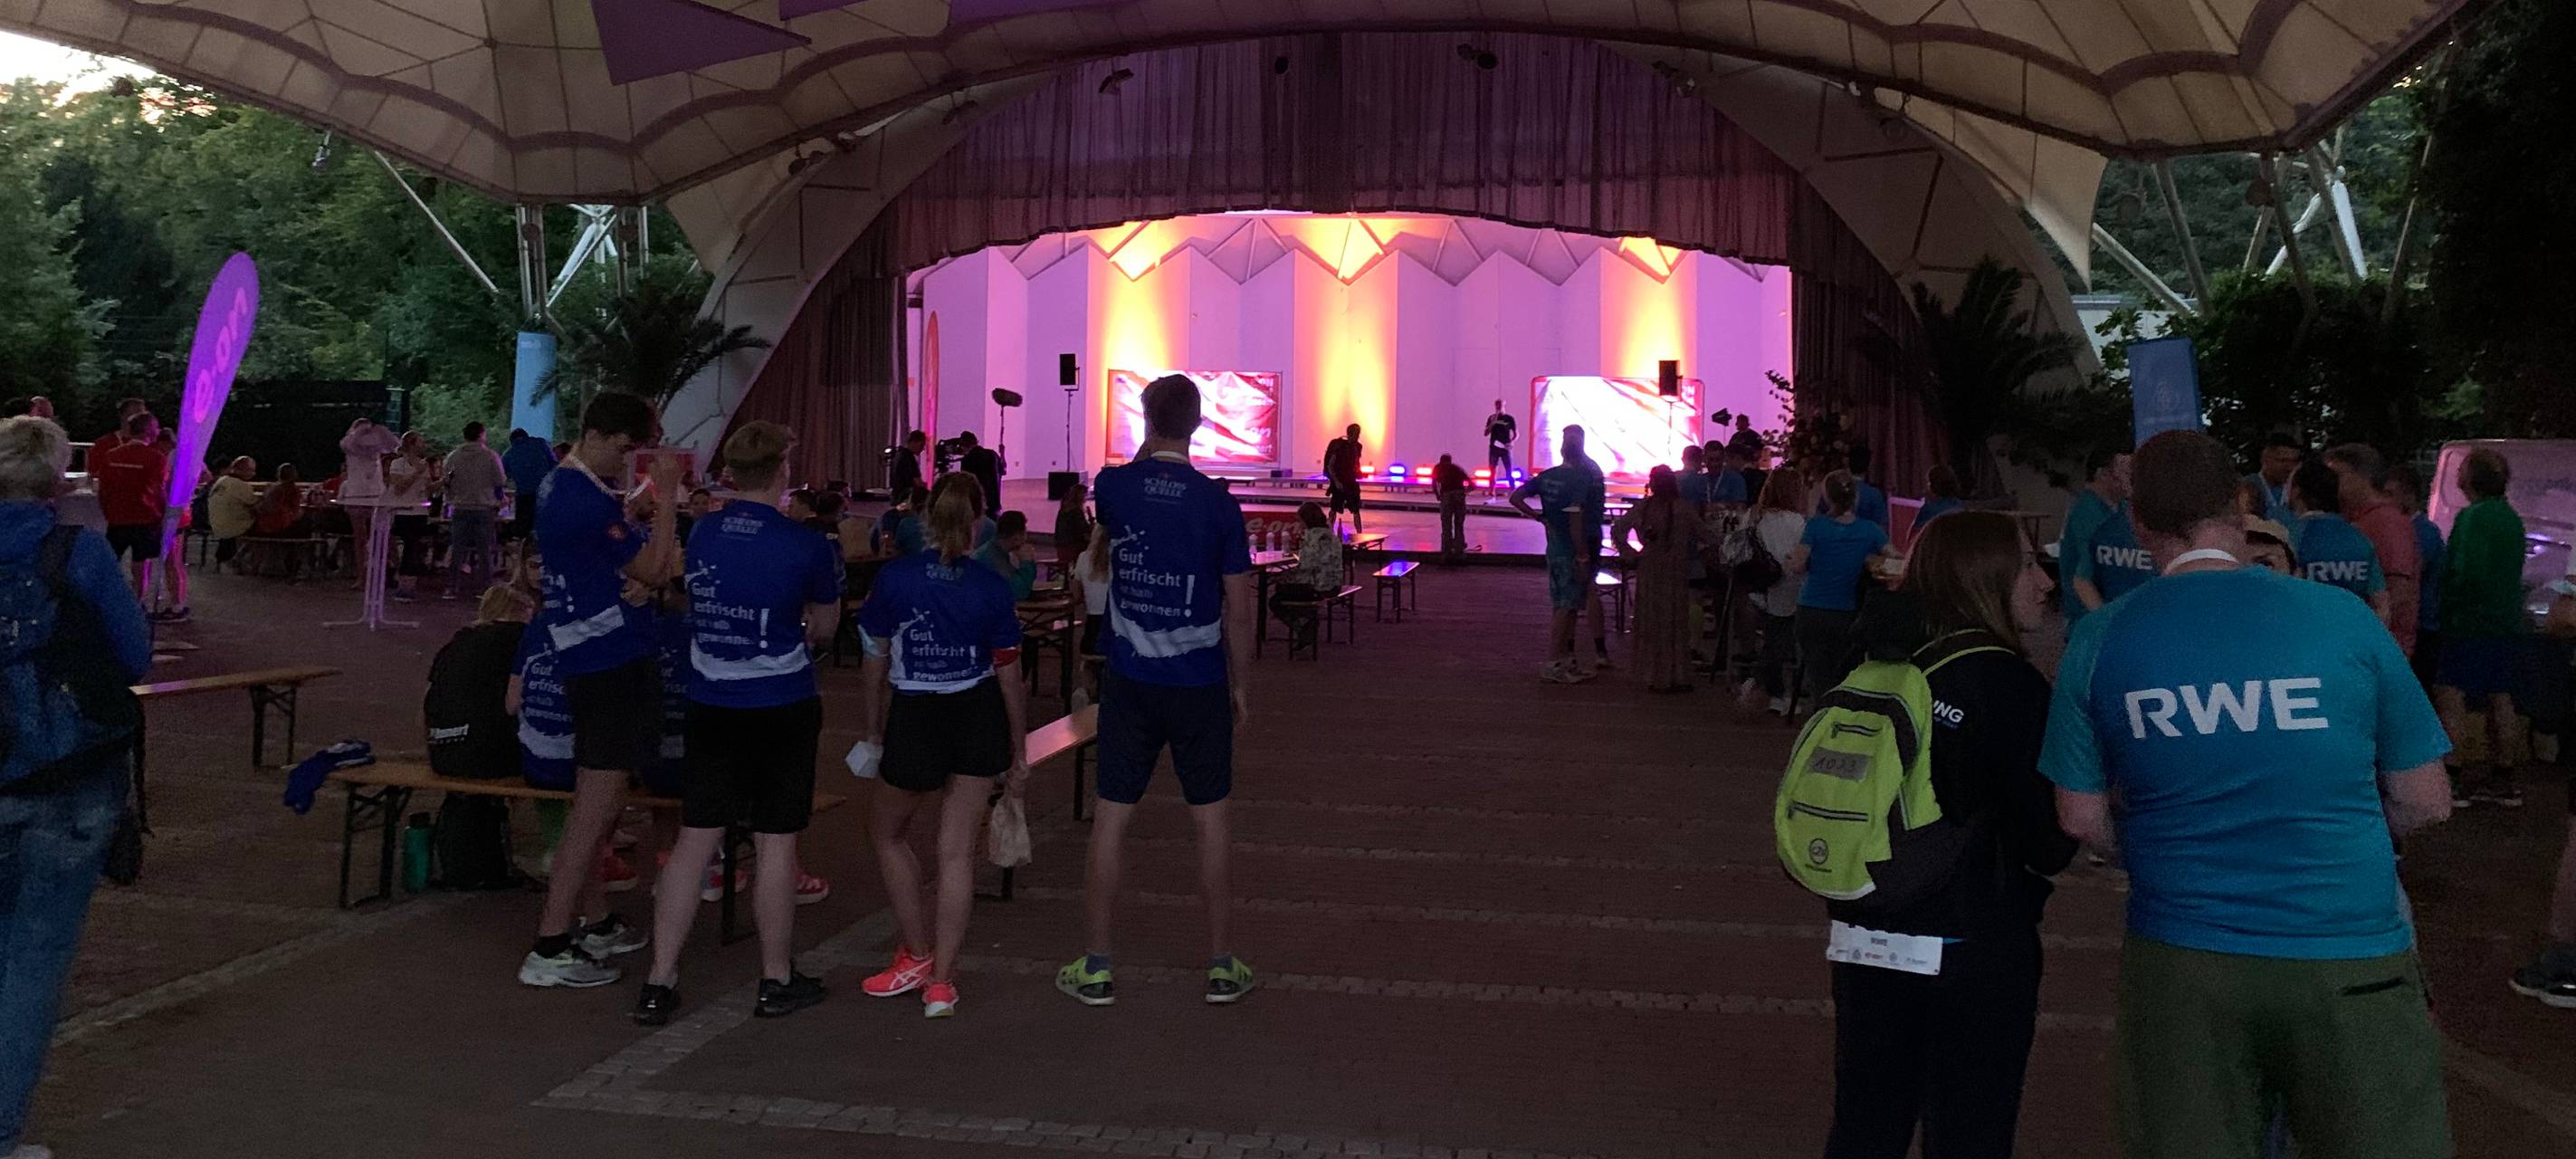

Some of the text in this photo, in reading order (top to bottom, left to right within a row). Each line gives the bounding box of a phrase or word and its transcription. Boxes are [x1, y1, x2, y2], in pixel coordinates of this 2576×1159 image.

[1118, 548, 1144, 566] Gut
[2095, 544, 2153, 570] RWE
[1118, 567, 1181, 588] erfrischt
[2308, 560, 2369, 582] RWE
[692, 582, 716, 598] Gut
[694, 601, 756, 621] erfrischt
[2124, 677, 2330, 739] RWE
